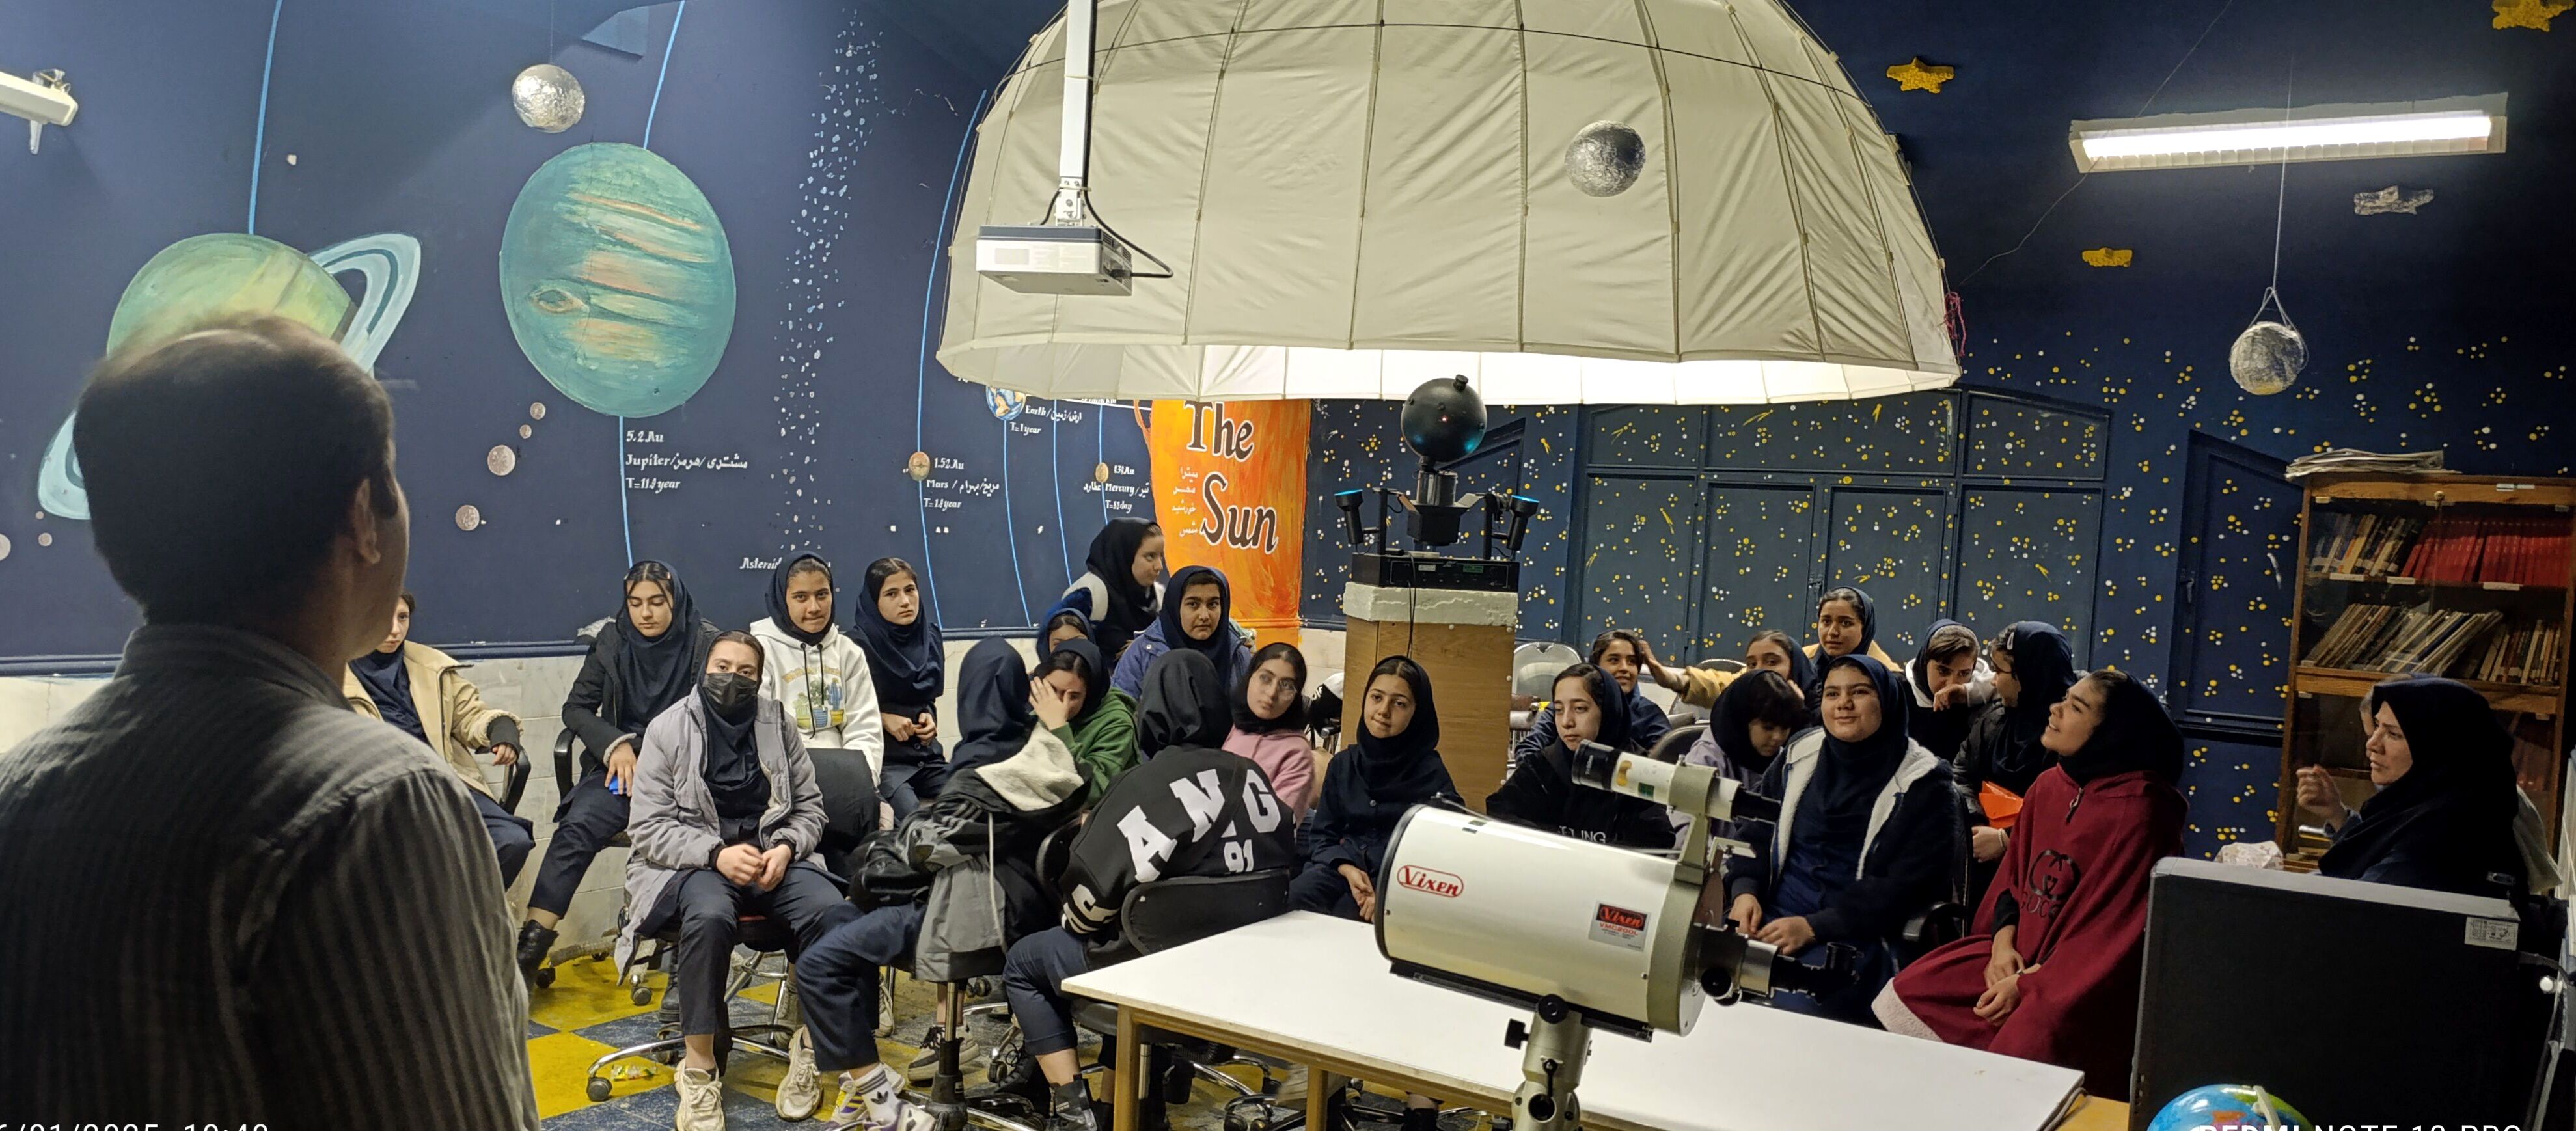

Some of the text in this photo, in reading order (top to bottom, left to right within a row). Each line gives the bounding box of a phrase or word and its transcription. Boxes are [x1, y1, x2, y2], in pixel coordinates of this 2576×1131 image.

[1183, 400, 1255, 462] The
[926, 479, 949, 489] Mars
[1105, 483, 1134, 497] Mercury
[1199, 471, 1279, 555] Sun
[1401, 866, 1460, 896] Vixen
[1603, 906, 1641, 927] Vixen
